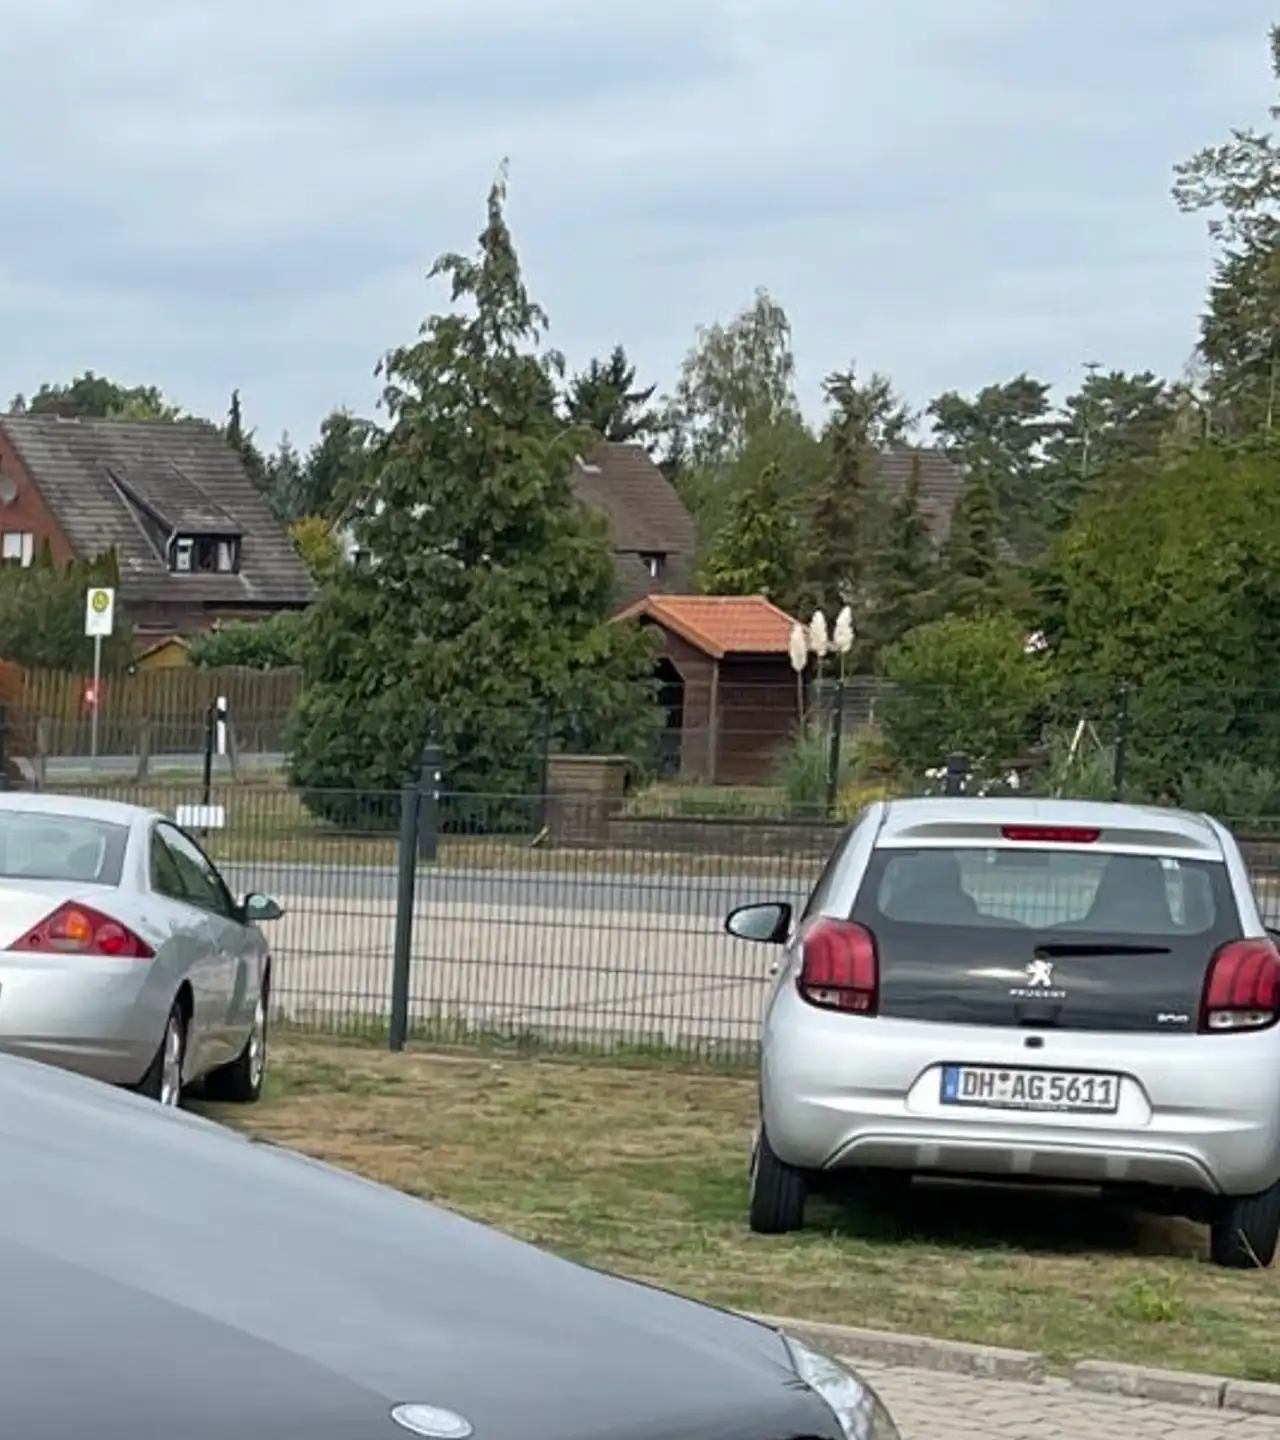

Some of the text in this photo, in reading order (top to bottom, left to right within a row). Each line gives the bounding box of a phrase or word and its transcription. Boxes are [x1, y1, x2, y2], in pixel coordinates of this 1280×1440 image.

[963, 1071, 1112, 1104] DH AG 5611
